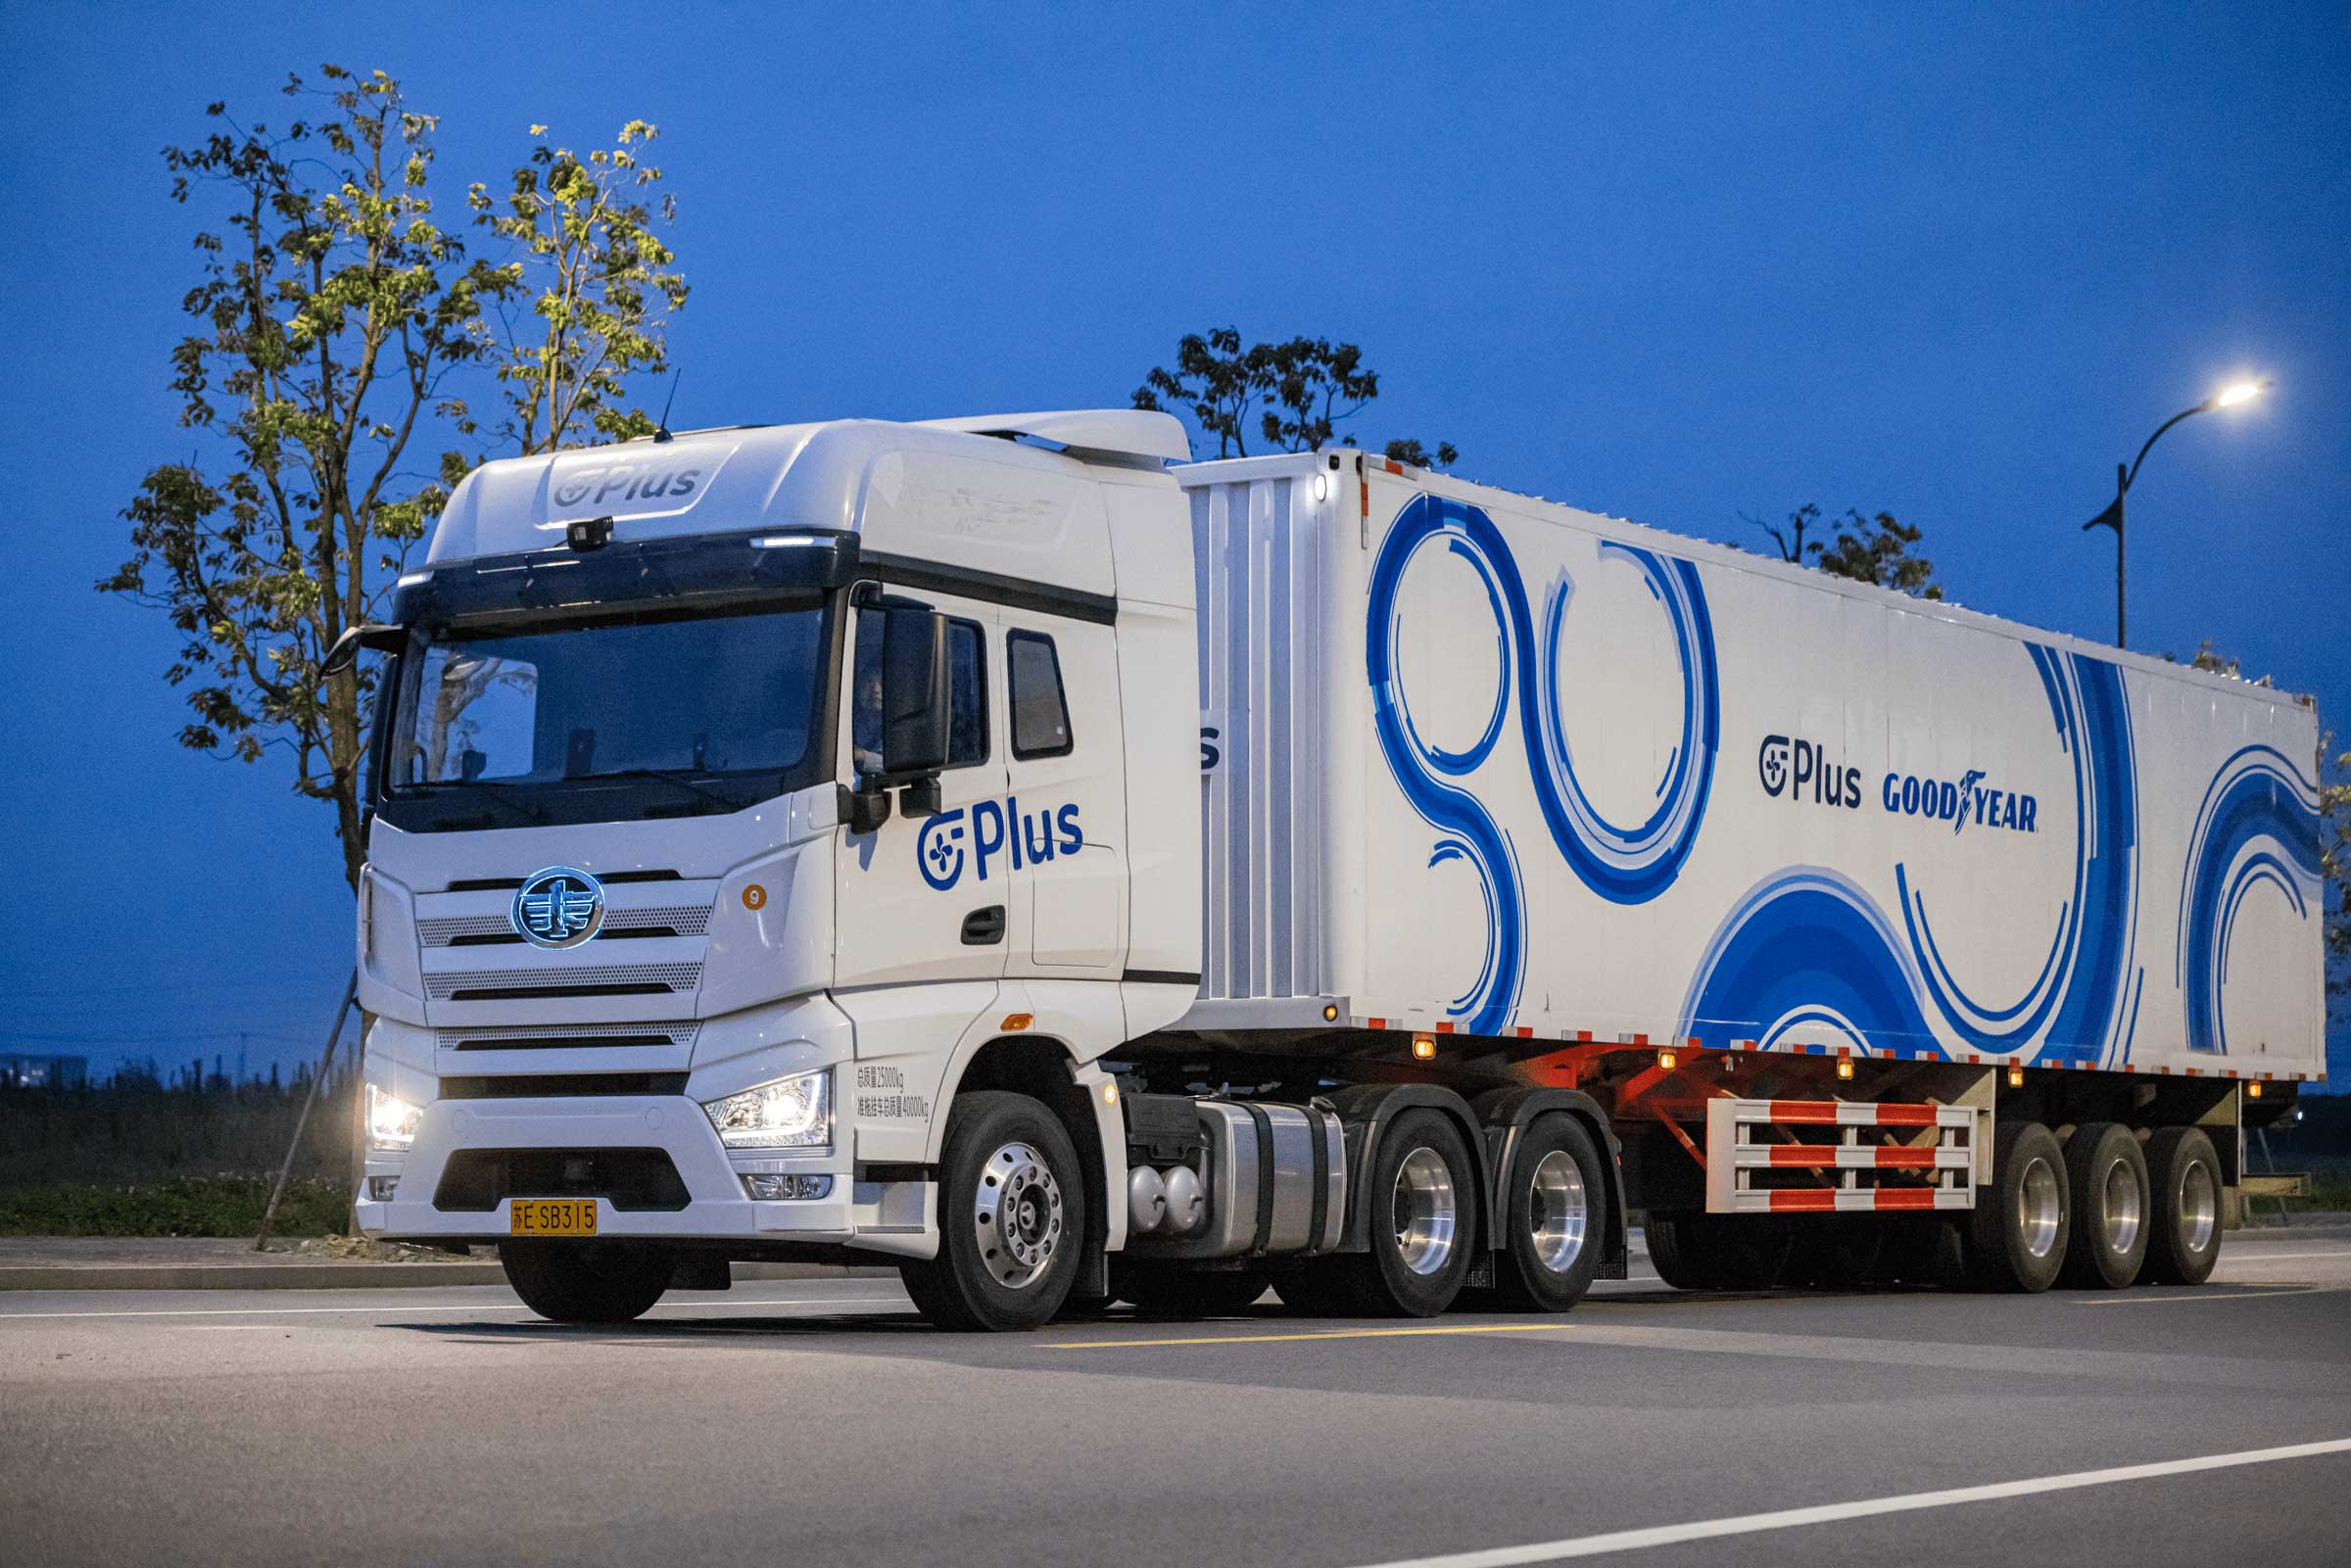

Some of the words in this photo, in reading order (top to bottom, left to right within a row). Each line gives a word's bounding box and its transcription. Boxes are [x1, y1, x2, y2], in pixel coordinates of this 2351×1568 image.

[594, 466, 701, 504] Plus
[1794, 738, 1862, 809] Plus
[972, 796, 1082, 880] Plus
[749, 889, 761, 905] 9
